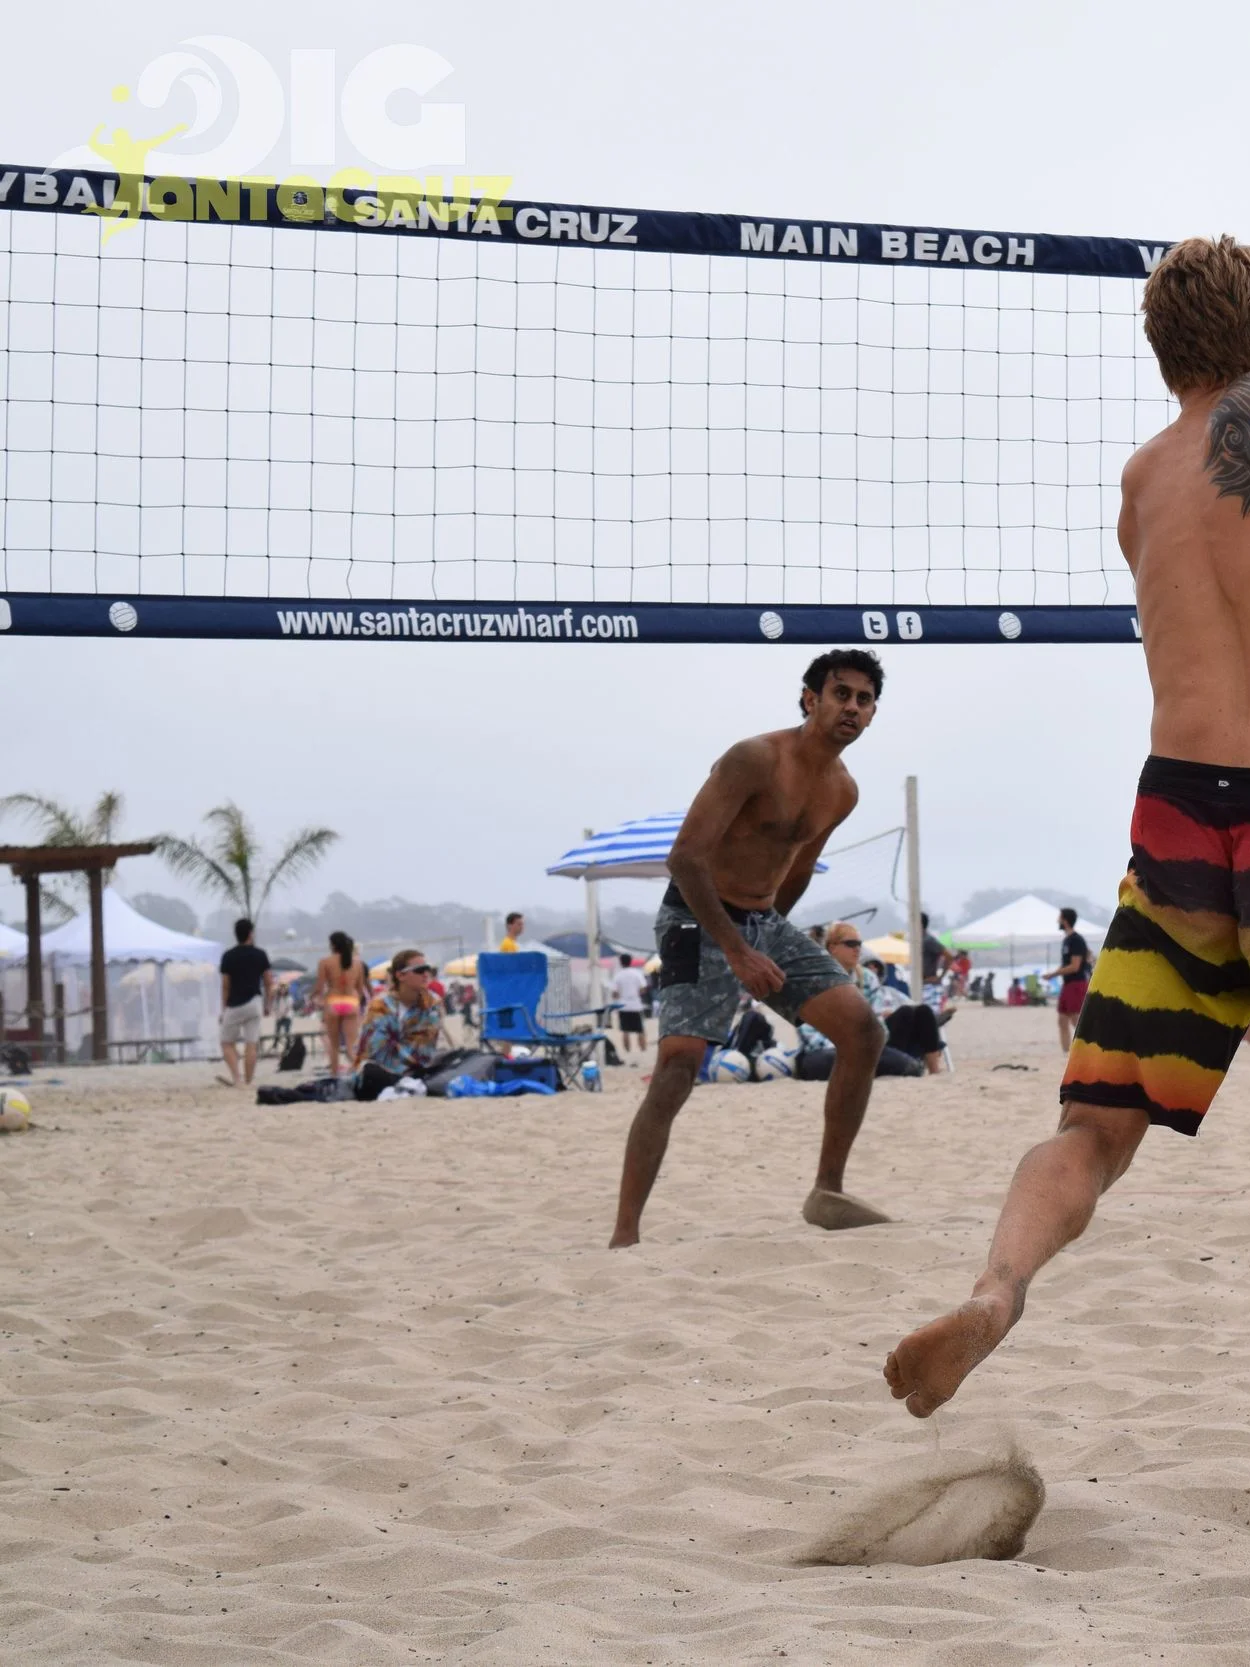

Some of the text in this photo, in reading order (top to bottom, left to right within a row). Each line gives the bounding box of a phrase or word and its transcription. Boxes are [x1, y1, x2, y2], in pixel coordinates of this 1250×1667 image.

[352, 195, 503, 236] SANTA
[515, 207, 639, 244] CRUZ
[739, 222, 1035, 267] MAIN BEACH
[276, 607, 639, 638] www.santacruzwharf.com
